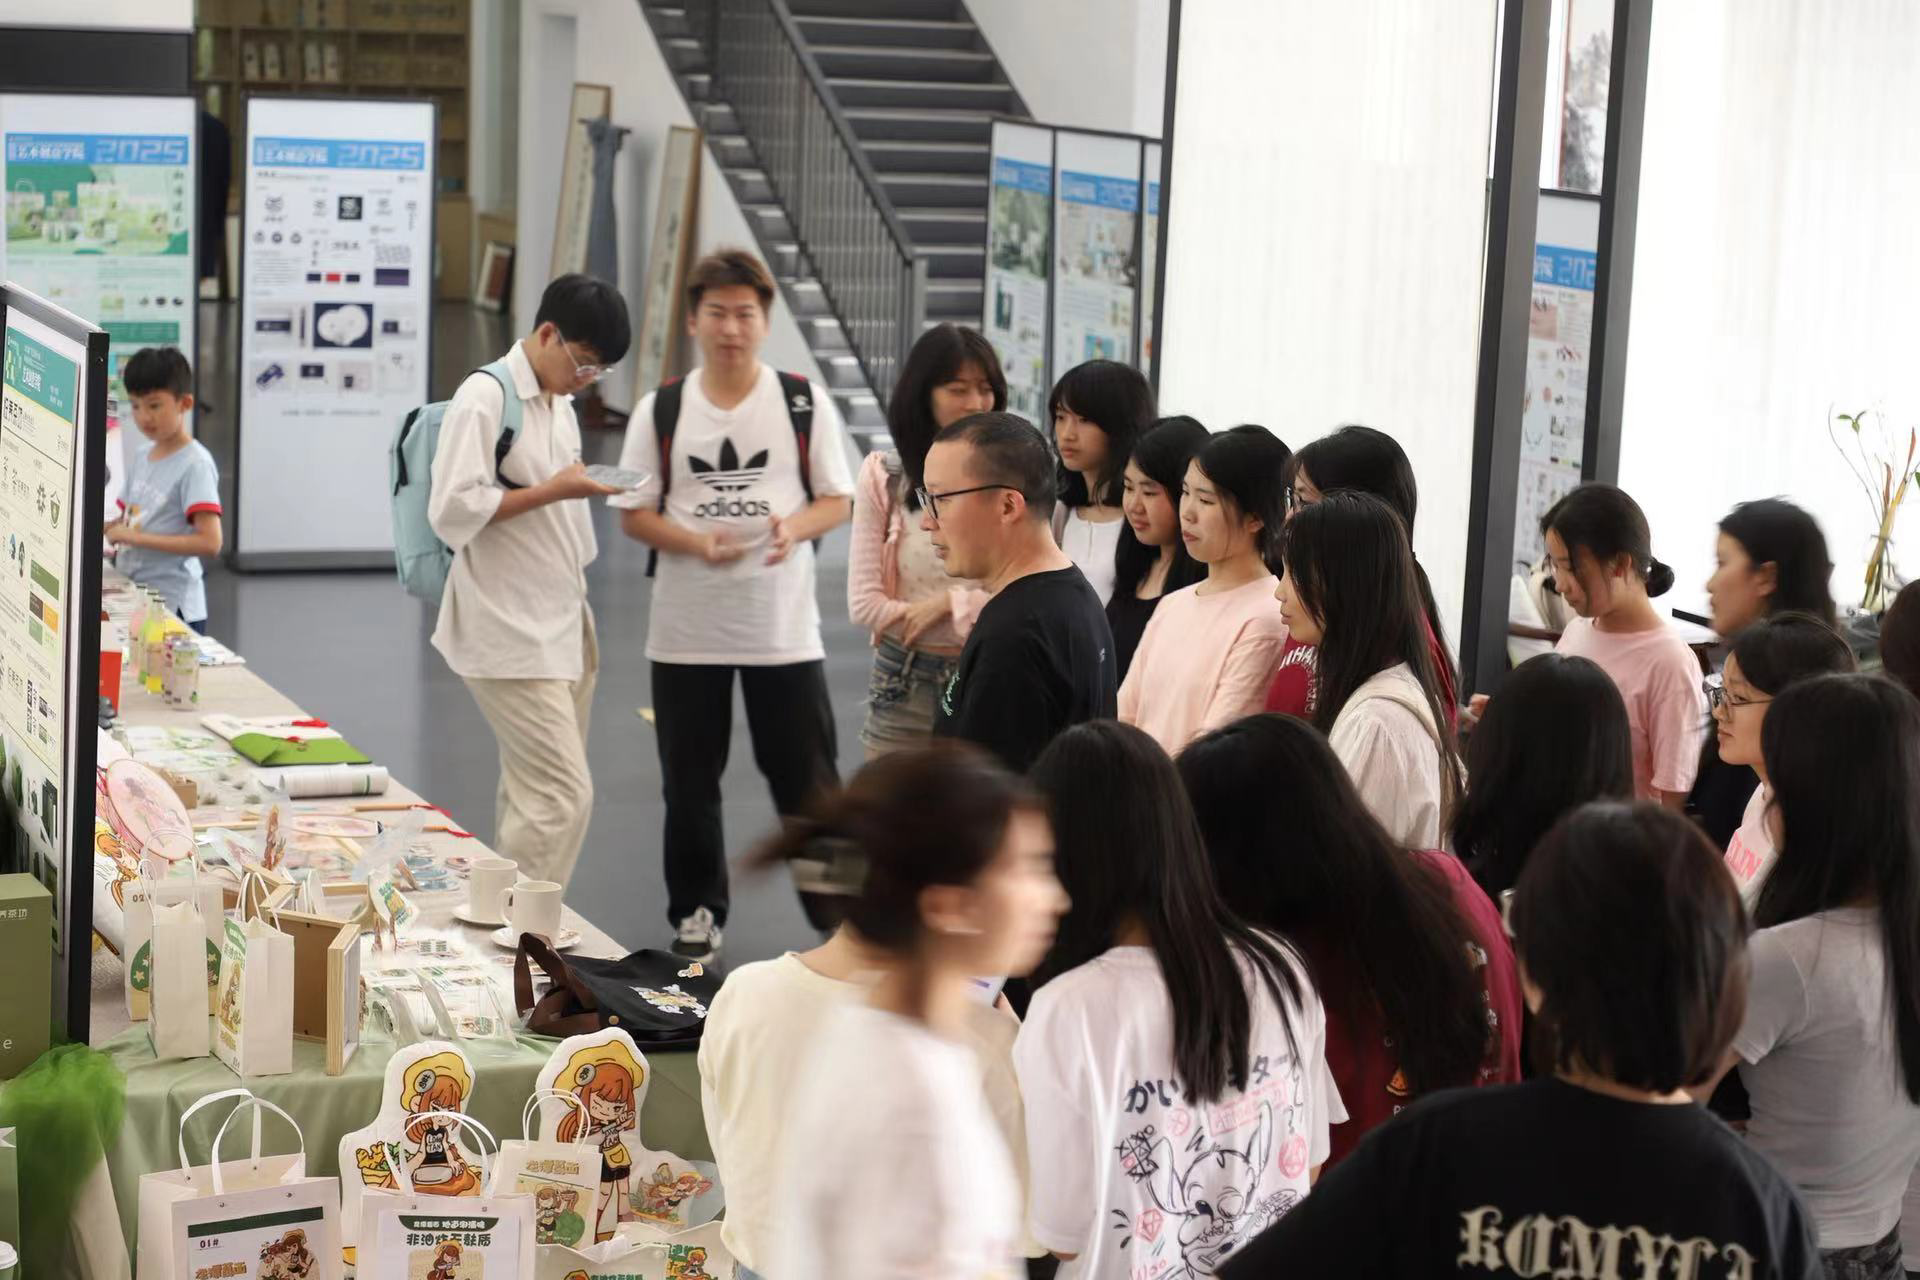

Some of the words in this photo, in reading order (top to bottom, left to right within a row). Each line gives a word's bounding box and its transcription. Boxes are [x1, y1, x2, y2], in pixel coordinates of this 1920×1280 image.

[96, 140, 185, 163] 2025
[337, 144, 424, 168] 2025
[694, 497, 770, 517] adidas
